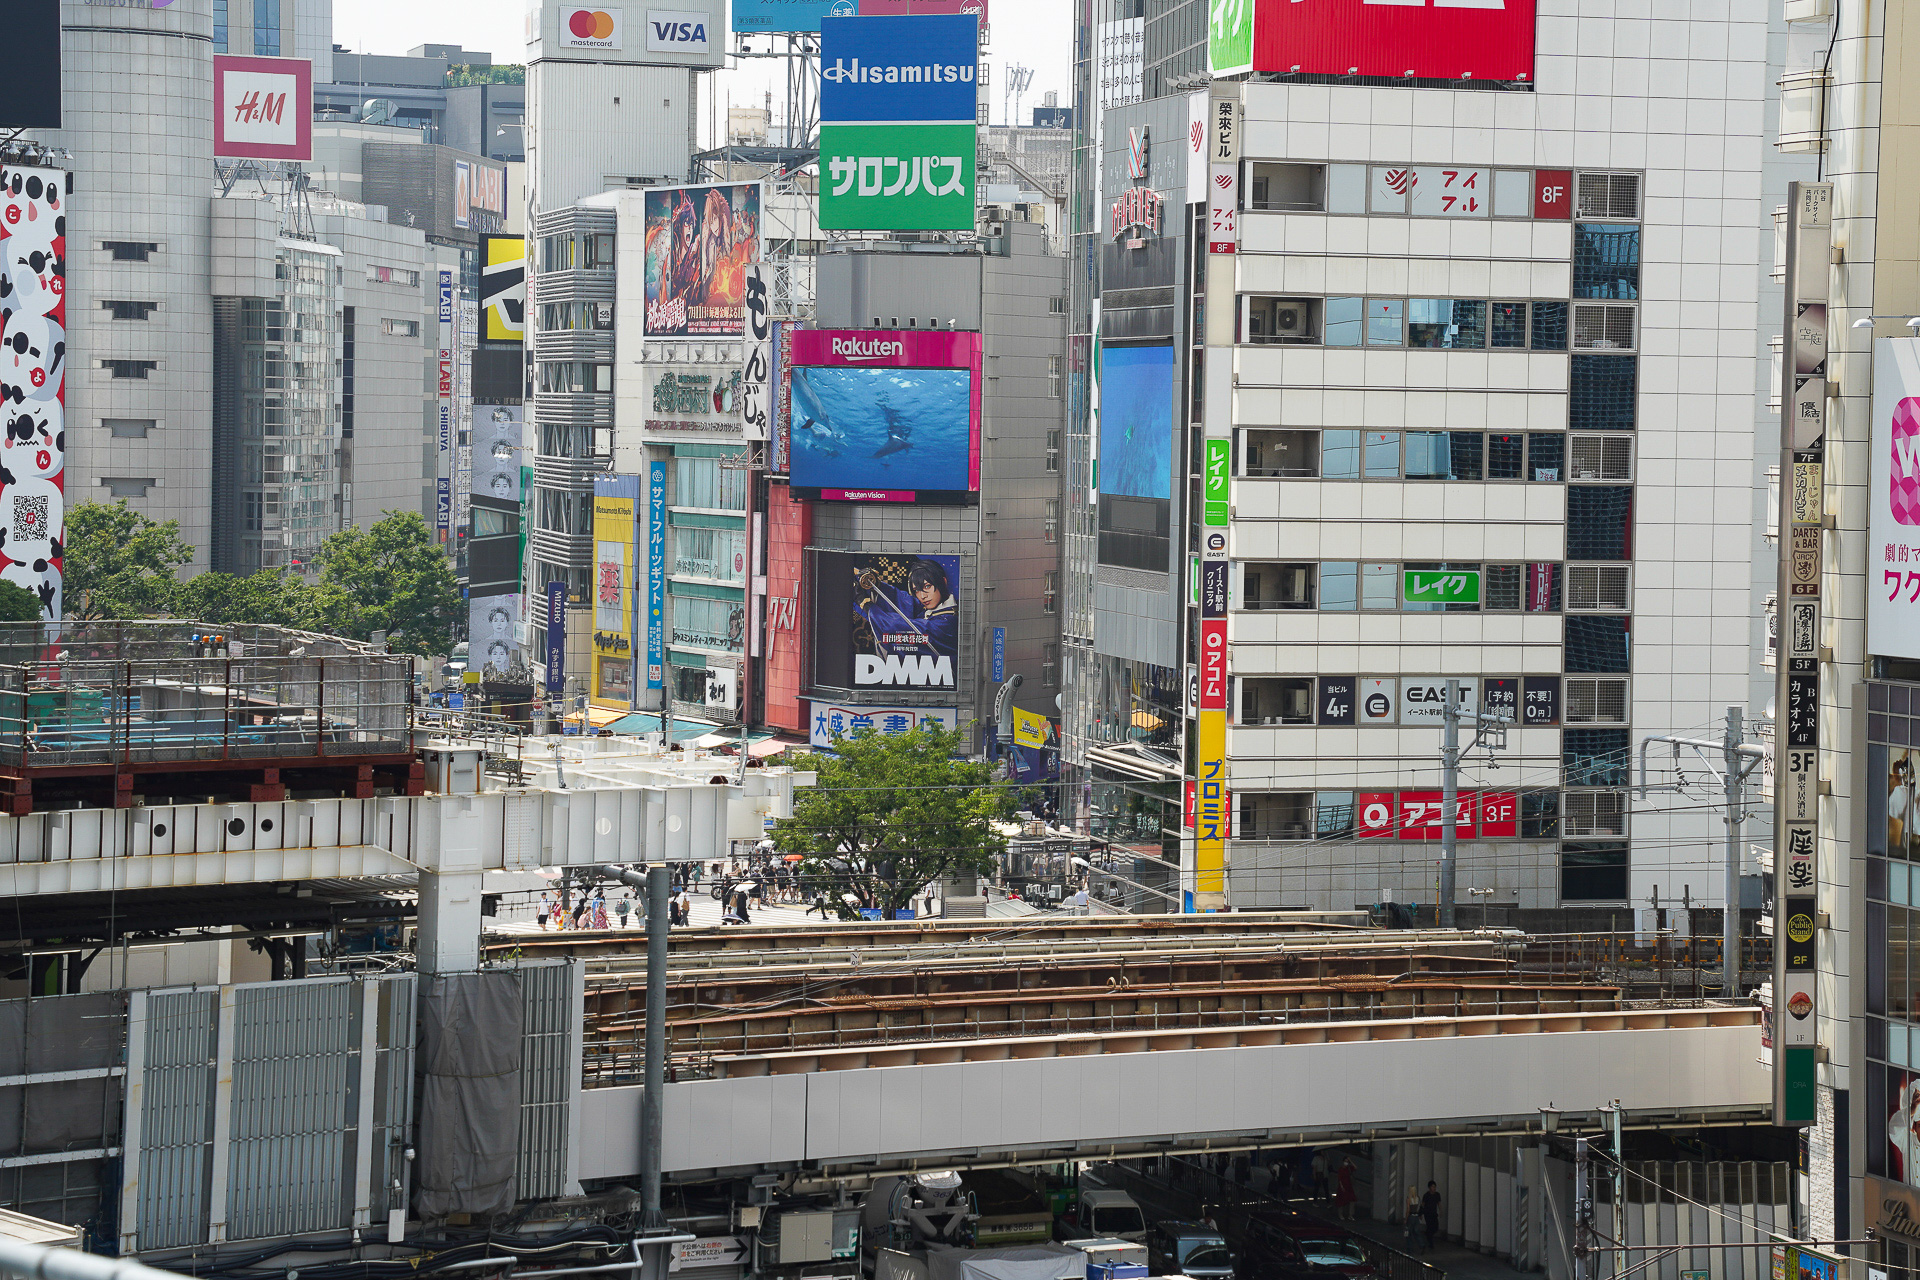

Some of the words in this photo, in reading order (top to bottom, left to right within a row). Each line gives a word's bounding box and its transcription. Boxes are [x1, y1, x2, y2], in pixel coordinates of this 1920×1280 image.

[650, 21, 707, 43] VISA
[570, 39, 613, 48] mastercard
[822, 57, 974, 84] Hisamitsu
[234, 90, 287, 126] H&M
[470, 162, 502, 213] LABI
[828, 155, 965, 198] サロンパス
[1542, 186, 1564, 204] 8F
[1112, 186, 1163, 241] MAGNET
[1216, 243, 1229, 253] 8F
[52, 279, 62, 290] れ
[440, 287, 451, 320] LABI
[744, 265, 768, 437] もんじゃ
[832, 336, 903, 356] Rakuten
[33, 371, 43, 383] よ
[440, 361, 451, 398] LABI
[440, 405, 449, 452] SHIBUYA
[1208, 446, 1225, 491] レイク
[1800, 453, 1815, 463] 7F
[1808, 464, 1819, 521] まーじゃん
[438, 493, 448, 526] LABI
[1793, 528, 1819, 538] DARTS
[1795, 540, 1800, 548] &
[1802, 538, 1819, 549] BAR
[650, 486, 664, 605] サマーフルーツギフト
[1796, 553, 1815, 561] JACK
[1206, 571, 1214, 607] クリニック
[1215, 565, 1224, 612] イースト駅前
[1413, 575, 1467, 595] レイク
[1796, 585, 1814, 594] 6F
[553, 590, 562, 624] MIZUHO
[551, 647, 560, 683] みずほ銀行
[855, 654, 955, 686] DMM
[1206, 651, 1221, 697] アコム
[1795, 659, 1811, 669] 5F
[1327, 685, 1348, 694] 当ビル
[1326, 697, 1348, 718] 4F
[1790, 681, 1801, 733] カラオケ
[1806, 688, 1816, 727] BAR
[1796, 733, 1809, 742] 4F
[1789, 753, 1815, 772] 3F
[1202, 759, 1223, 842] プロミス
[1486, 805, 1512, 823] 3F
[1790, 921, 1811, 930] Public
[1790, 928, 1811, 936] Stand
[1793, 955, 1808, 965] 2F
[1796, 1034, 1805, 1042] 1F
